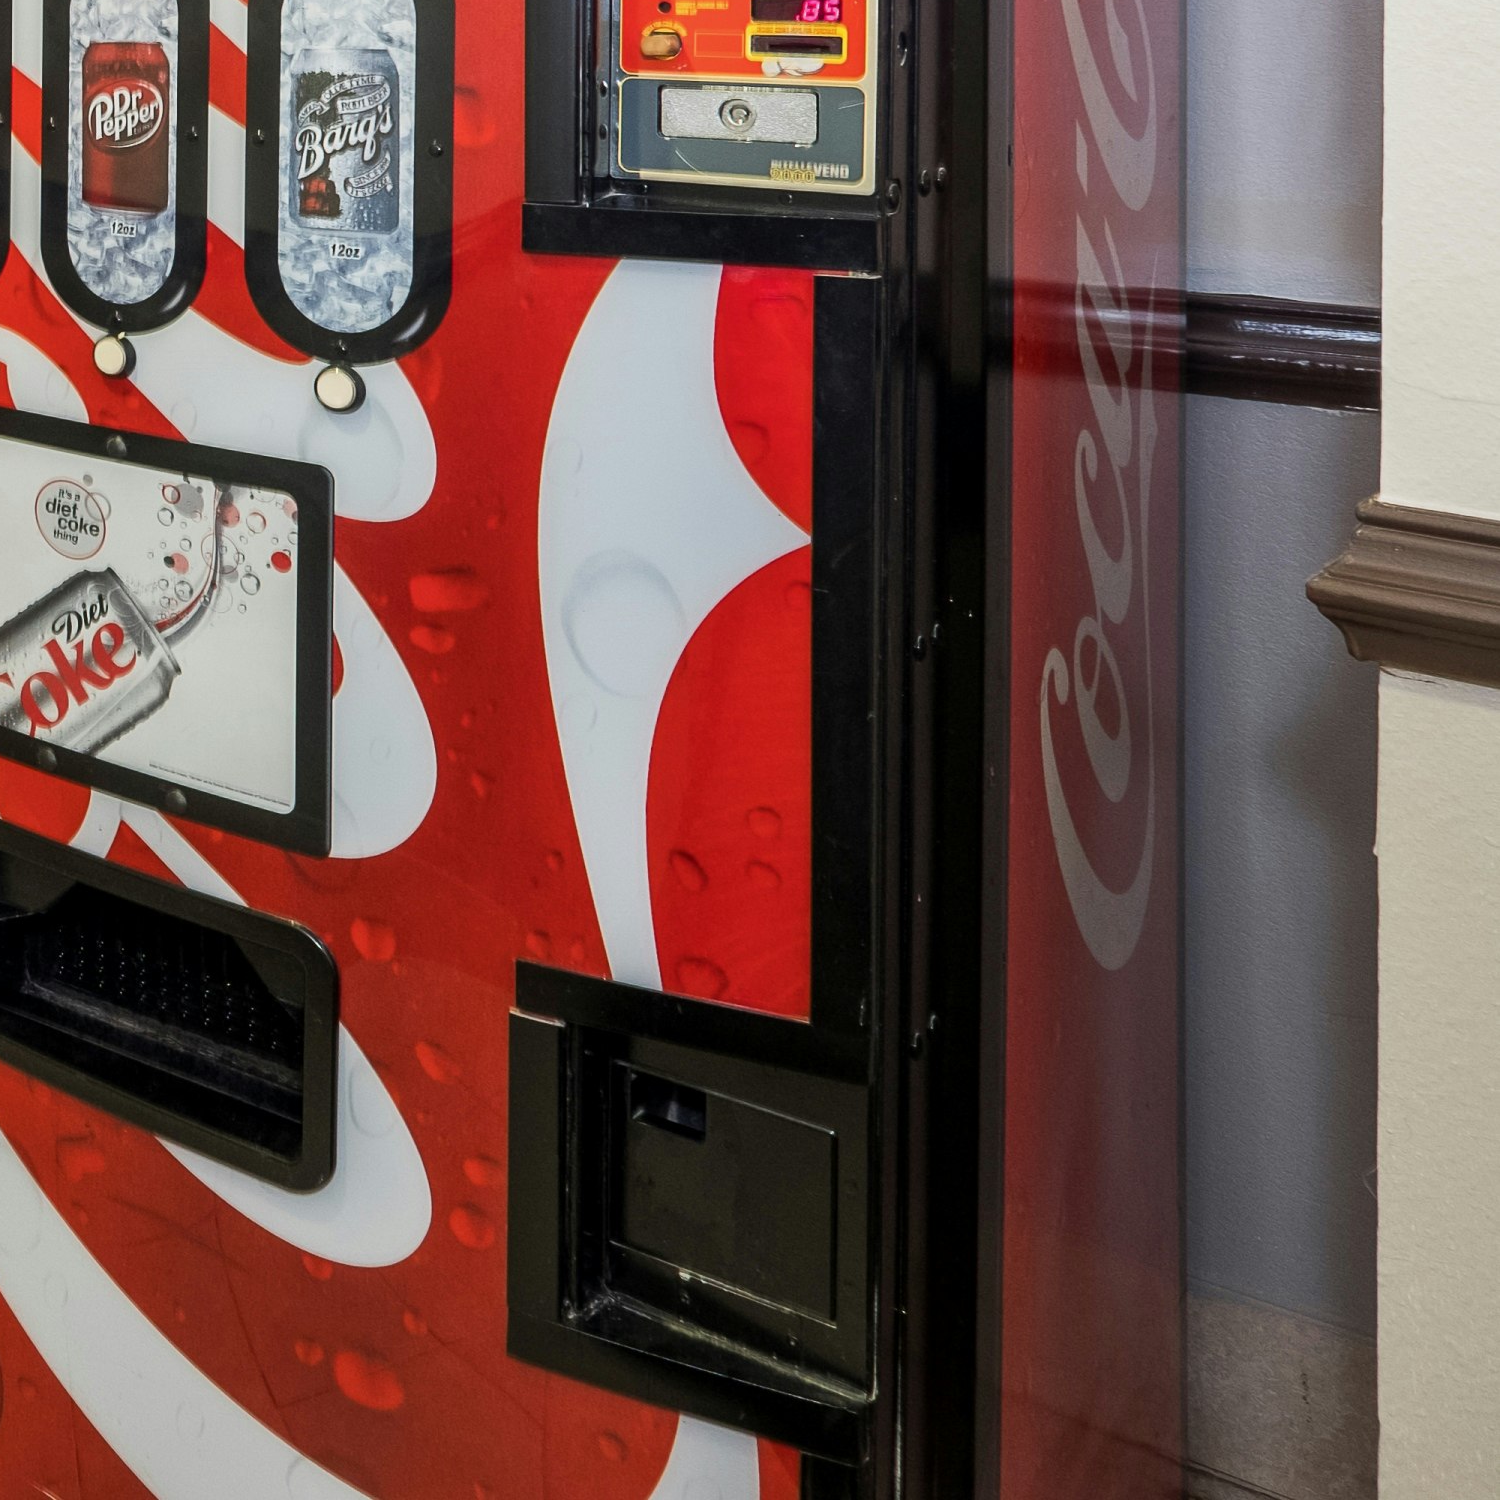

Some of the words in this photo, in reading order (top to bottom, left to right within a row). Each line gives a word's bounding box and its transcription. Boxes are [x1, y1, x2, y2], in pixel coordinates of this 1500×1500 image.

[114, 86, 142, 115] Dr
[341, 97, 366, 113] ROOT
[367, 85, 389, 106] BEER
[95, 93, 159, 141] Pepper
[295, 102, 394, 180] Barq's
[769, 168, 816, 184] 2000
[111, 221, 136, 236] 12oz
[330, 243, 361, 259] 12oz
[58, 488, 73, 500] it's
[45, 497, 79, 519] diet
[53, 528, 79, 546] thing
[57, 517, 100, 537] coke
[51, 592, 109, 644] Diet
